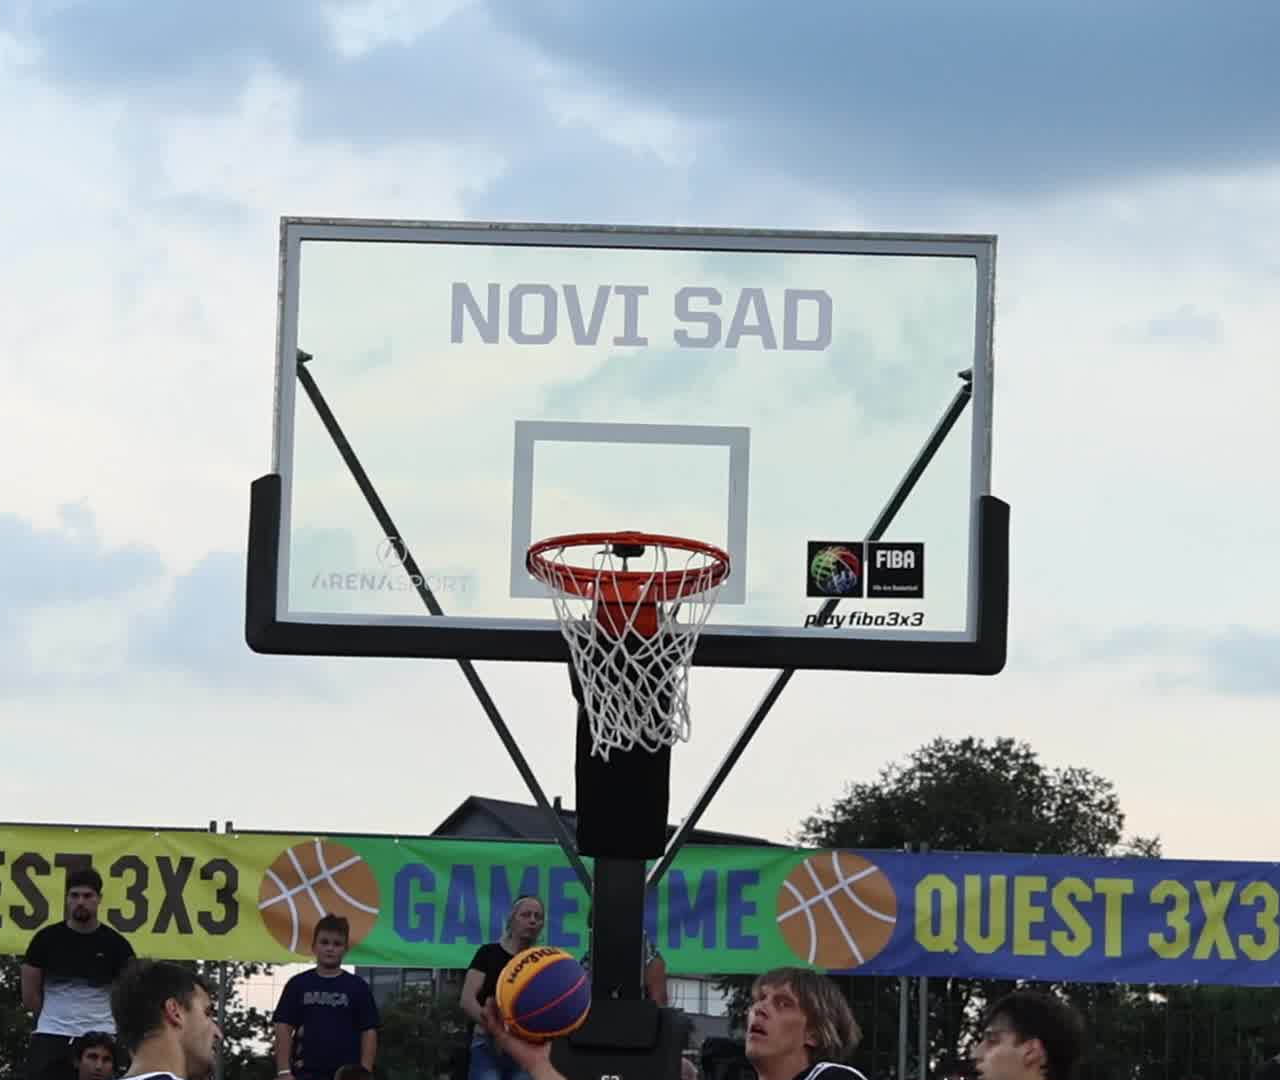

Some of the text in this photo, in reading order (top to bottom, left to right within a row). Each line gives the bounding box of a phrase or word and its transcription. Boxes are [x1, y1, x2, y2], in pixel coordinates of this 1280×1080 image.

[451, 282, 833, 351] NOVI SAD
[876, 550, 915, 568] FIBA
[107, 855, 239, 935] 3X3
[643, 868, 761, 950] IME
[914, 873, 1280, 961] QUEST 3X3
